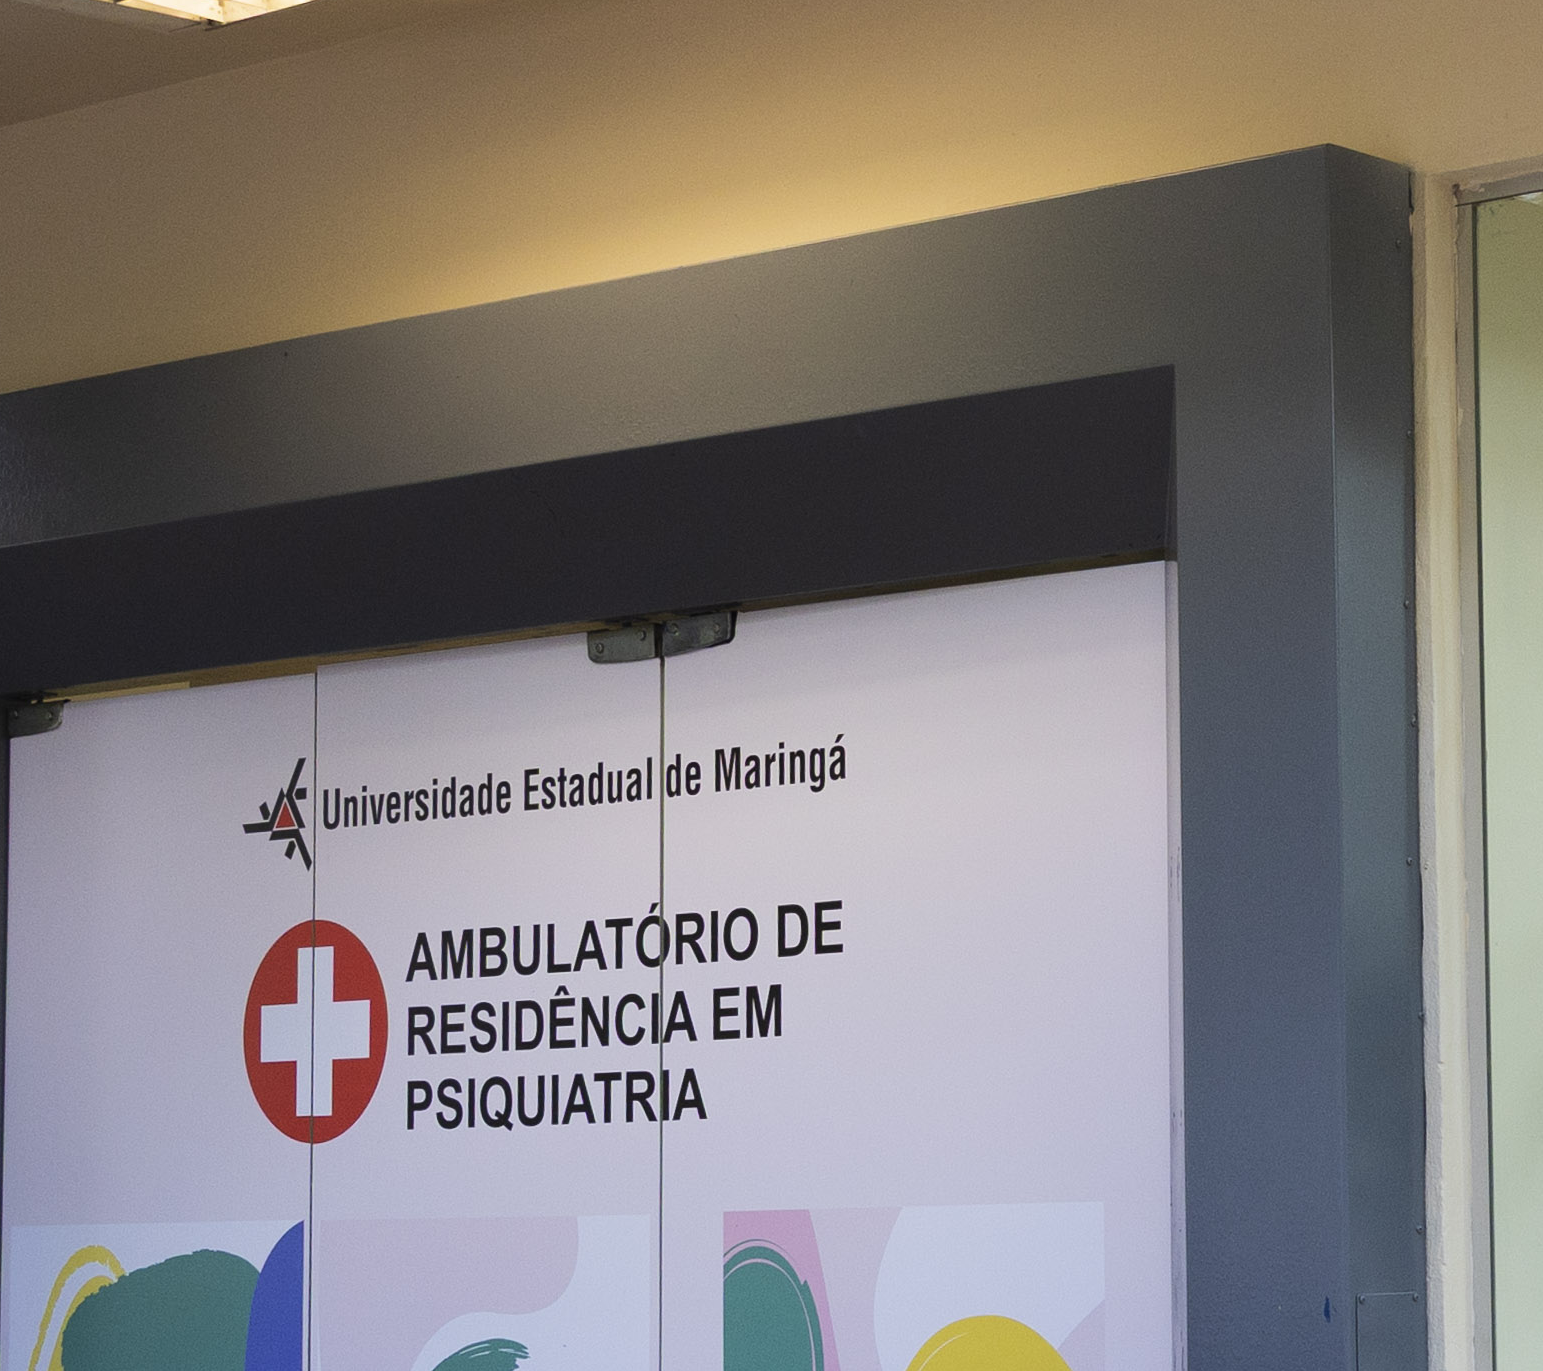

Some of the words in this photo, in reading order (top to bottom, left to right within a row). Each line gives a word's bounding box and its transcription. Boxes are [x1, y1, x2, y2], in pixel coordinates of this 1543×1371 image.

[322, 773, 512, 829] Universidade
[523, 757, 653, 811] Estadual
[665, 753, 701, 797] de
[714, 733, 847, 793] Maringá
[405, 902, 759, 982] AMBULATÓRIO
[777, 900, 844, 958] DE
[406, 985, 698, 1056] RESIDÊNCIA
[712, 984, 783, 1041] EM
[406, 1068, 708, 1131] PSIQUIATRIA
